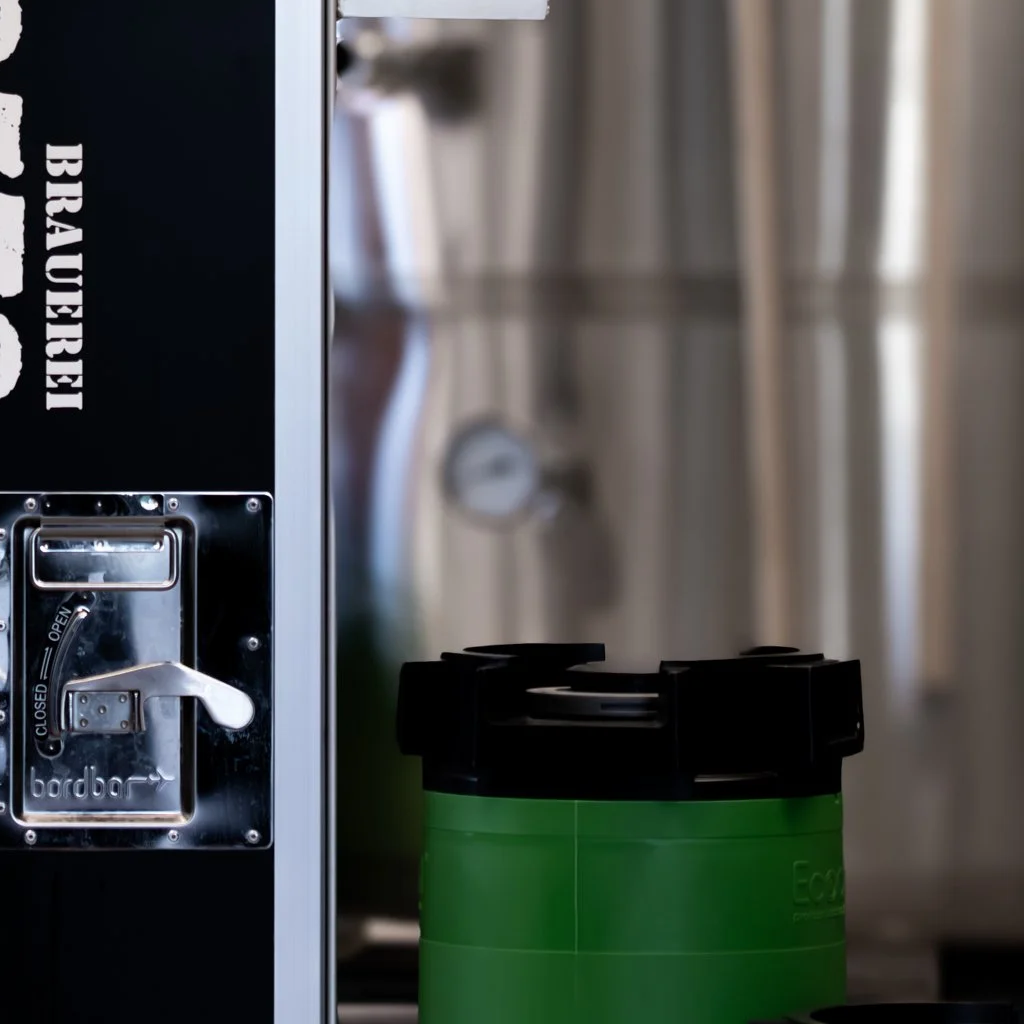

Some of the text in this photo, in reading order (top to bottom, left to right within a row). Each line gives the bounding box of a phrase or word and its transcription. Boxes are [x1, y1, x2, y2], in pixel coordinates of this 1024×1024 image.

[45, 143, 83, 410] BRAUEREI
[48, 606, 72, 642] OPEN
[34, 683, 48, 736] CLOSED
[30, 766, 147, 800] bordbar
